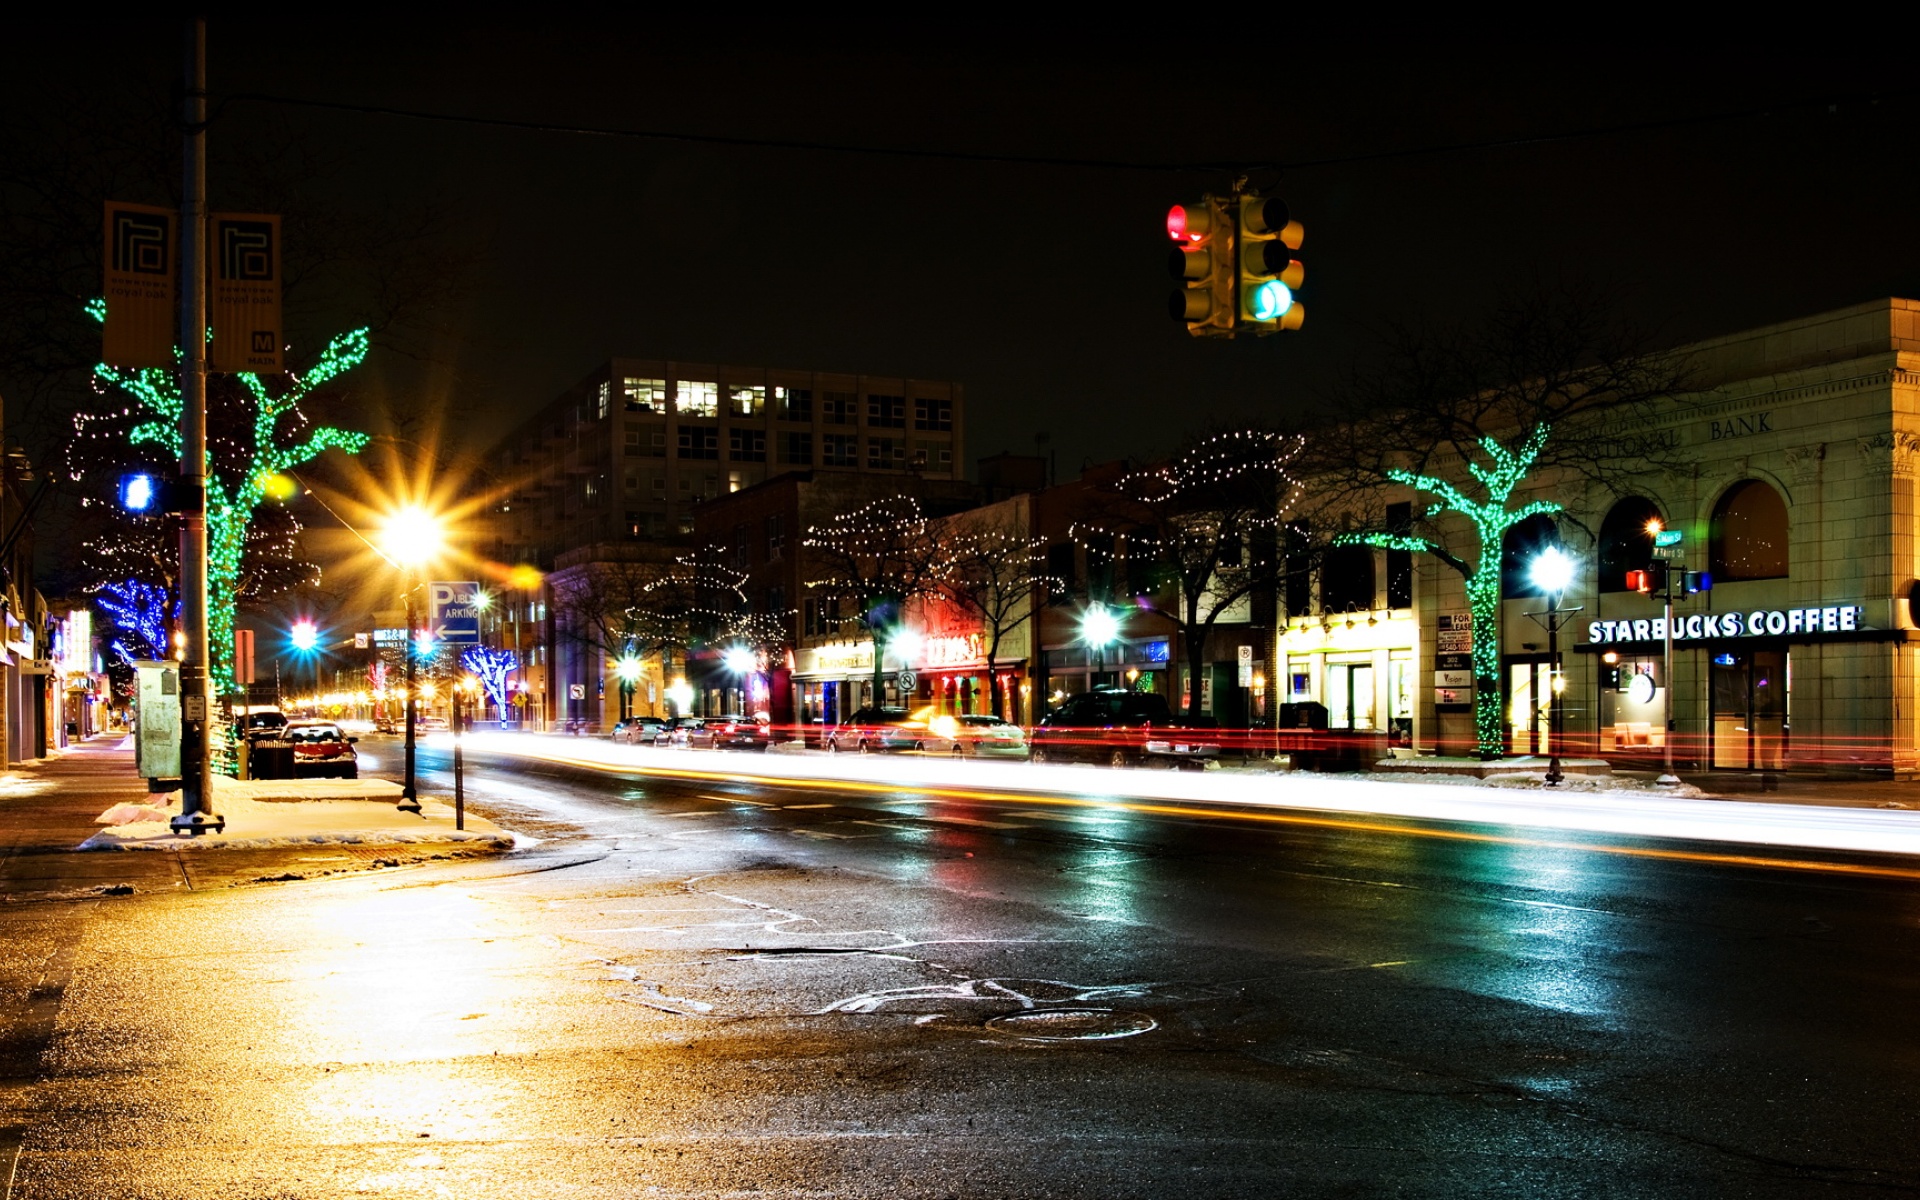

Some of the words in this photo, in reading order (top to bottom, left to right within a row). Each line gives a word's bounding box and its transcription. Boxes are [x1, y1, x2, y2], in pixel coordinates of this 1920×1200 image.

[111, 277, 168, 288] DOWNTOWN
[111, 286, 142, 299] royal
[145, 289, 167, 300] oak
[219, 295, 249, 305] royal
[252, 296, 274, 305] oak
[247, 357, 276, 366] MAIN
[1710, 411, 1773, 440] BANK
[1454, 615, 1470, 623] FOR
[1452, 623, 1472, 631] LEASE
[1588, 612, 1743, 644] STARBUCKS
[1747, 606, 1858, 636] COFFEE
[1444, 673, 1463, 683] Vision
[1185, 679, 1209, 692] LSE
